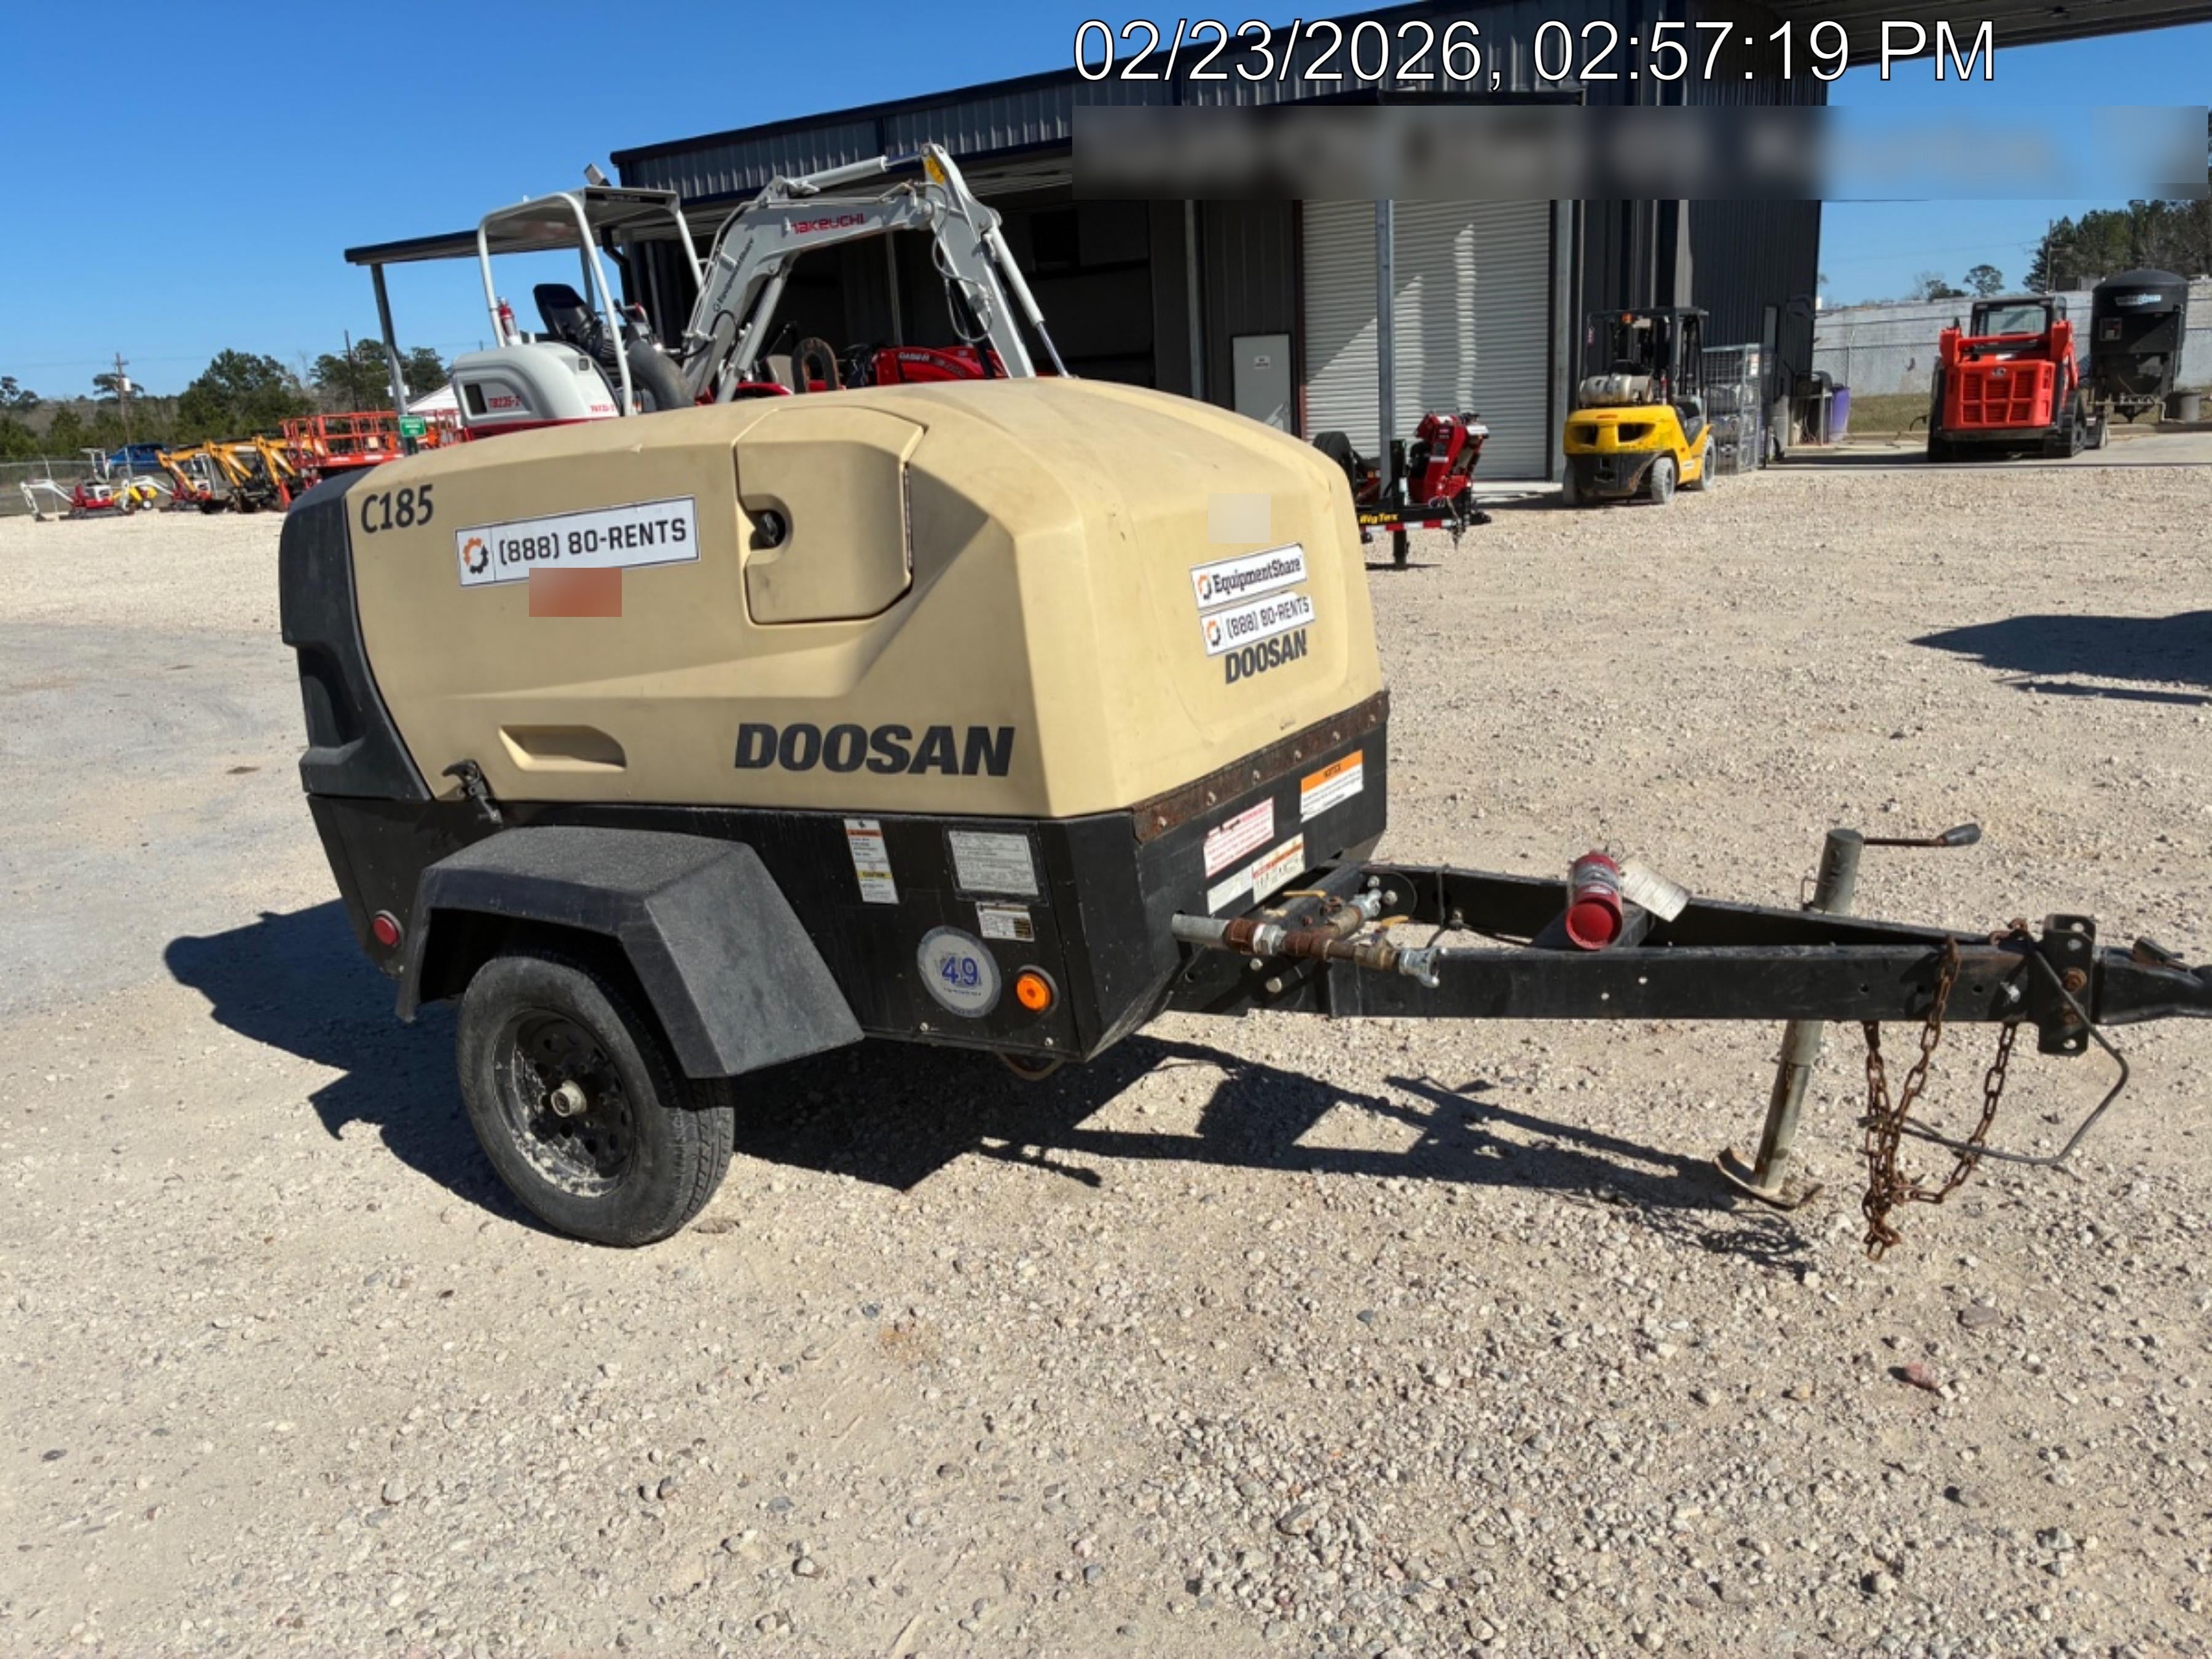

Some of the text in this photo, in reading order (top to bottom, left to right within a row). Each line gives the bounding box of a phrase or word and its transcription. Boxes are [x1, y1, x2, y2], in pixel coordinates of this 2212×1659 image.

[361, 484, 434, 533] C185
[498, 518, 687, 566] (888) 80-RENTS
[1212, 557, 1301, 595] EquipmentShare
[1226, 597, 1310, 639] (888) 80-RENTS
[1225, 629, 1308, 684] DOOSAN
[734, 723, 1016, 777] DOOSAN
[941, 956, 978, 986] 49
